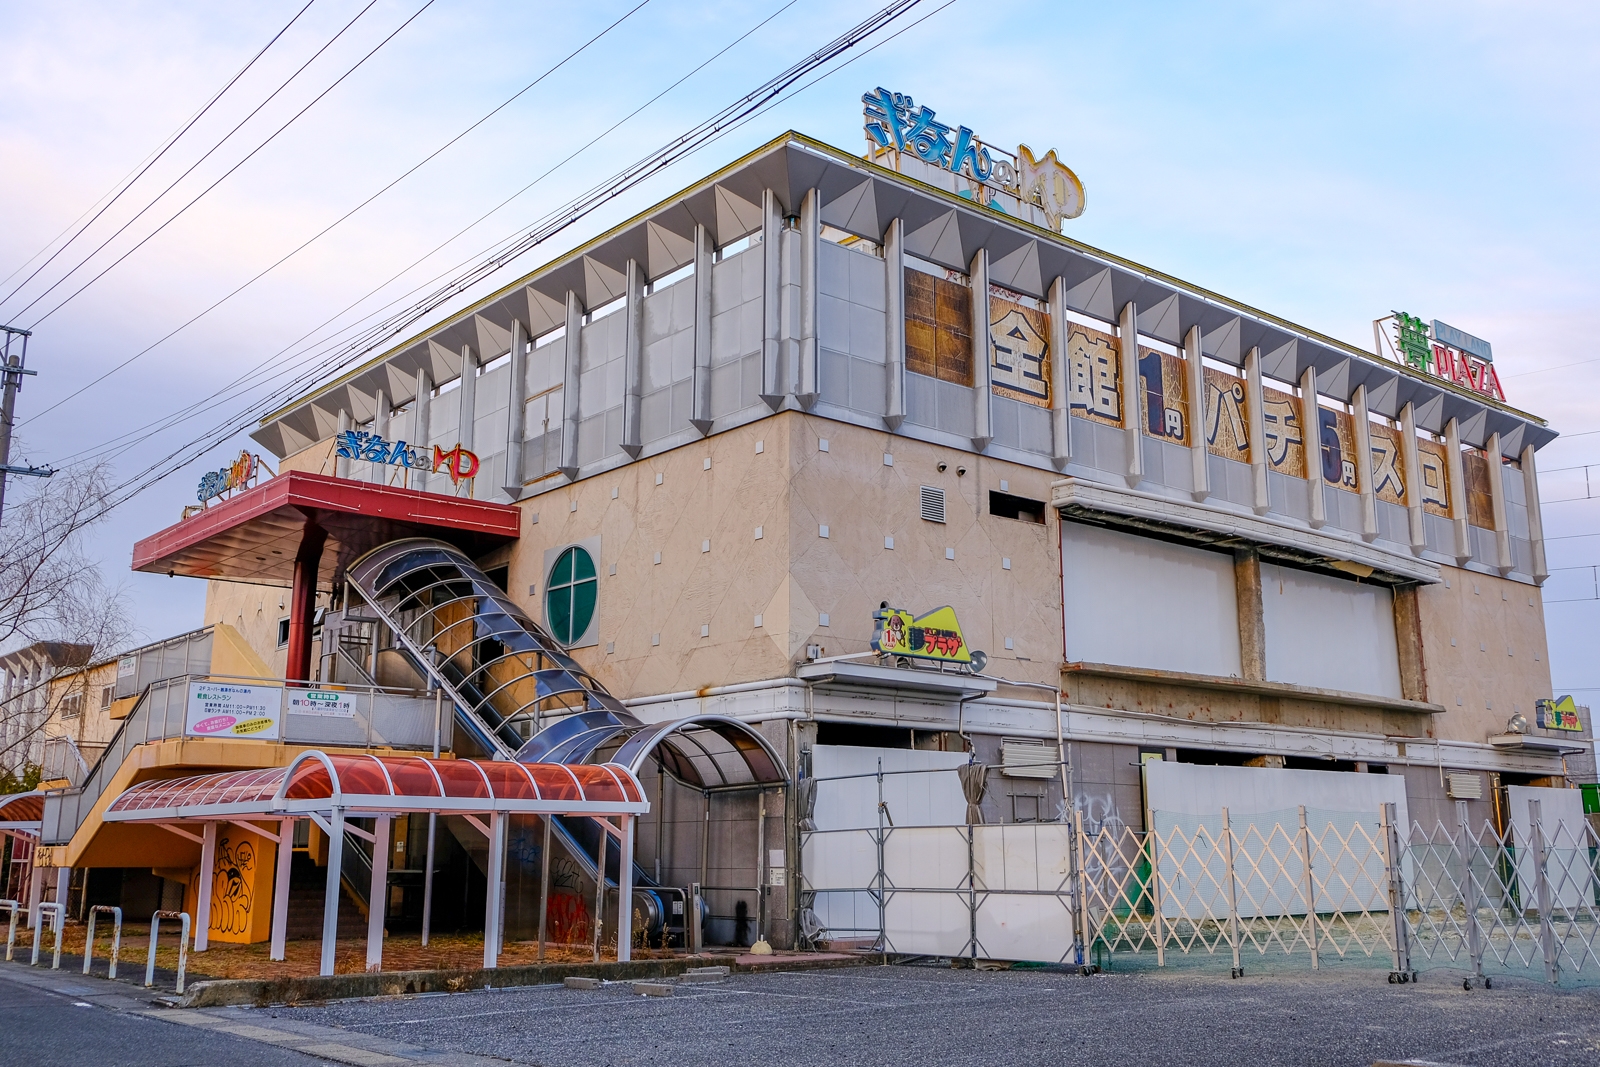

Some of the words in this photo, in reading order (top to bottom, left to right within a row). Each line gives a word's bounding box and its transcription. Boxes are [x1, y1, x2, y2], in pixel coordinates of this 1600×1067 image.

[862, 86, 1087, 233] ぎなんのゆ
[1437, 323, 1462, 343] PLAY
[1465, 332, 1491, 357] LAND
[1432, 344, 1506, 402] PLAZA
[336, 429, 480, 486] ぎなんのゆ
